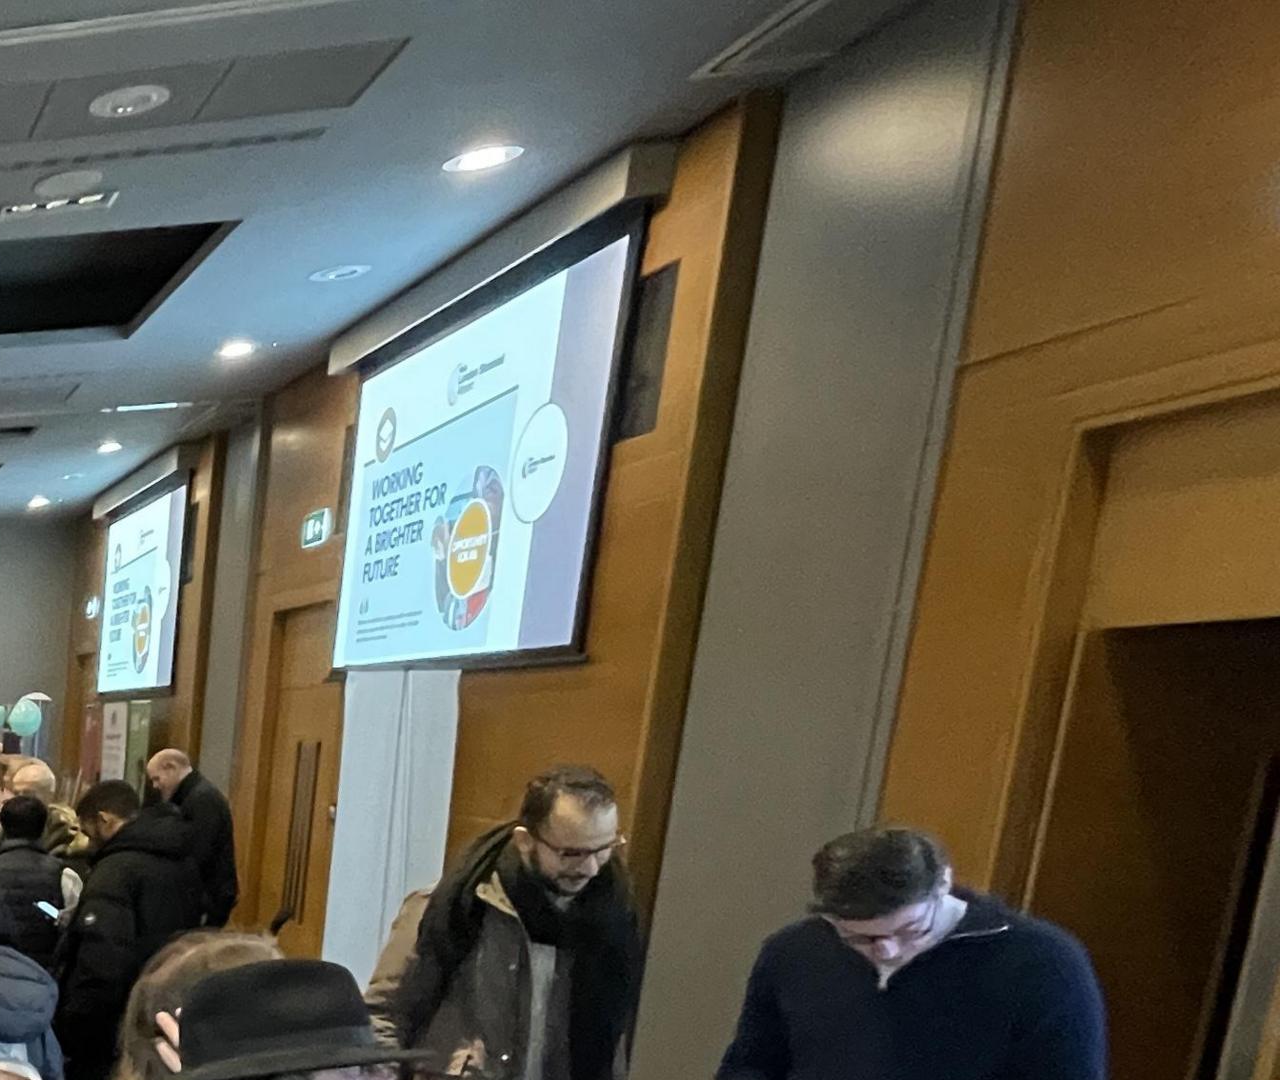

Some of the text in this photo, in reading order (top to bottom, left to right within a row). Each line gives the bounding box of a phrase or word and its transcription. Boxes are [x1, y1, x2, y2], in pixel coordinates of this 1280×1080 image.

[372, 462, 423, 500] WORKING
[369, 482, 447, 528] TOGETHER FOR
[365, 519, 424, 556] A BRIGHTER
[363, 554, 400, 583] FUTURE
